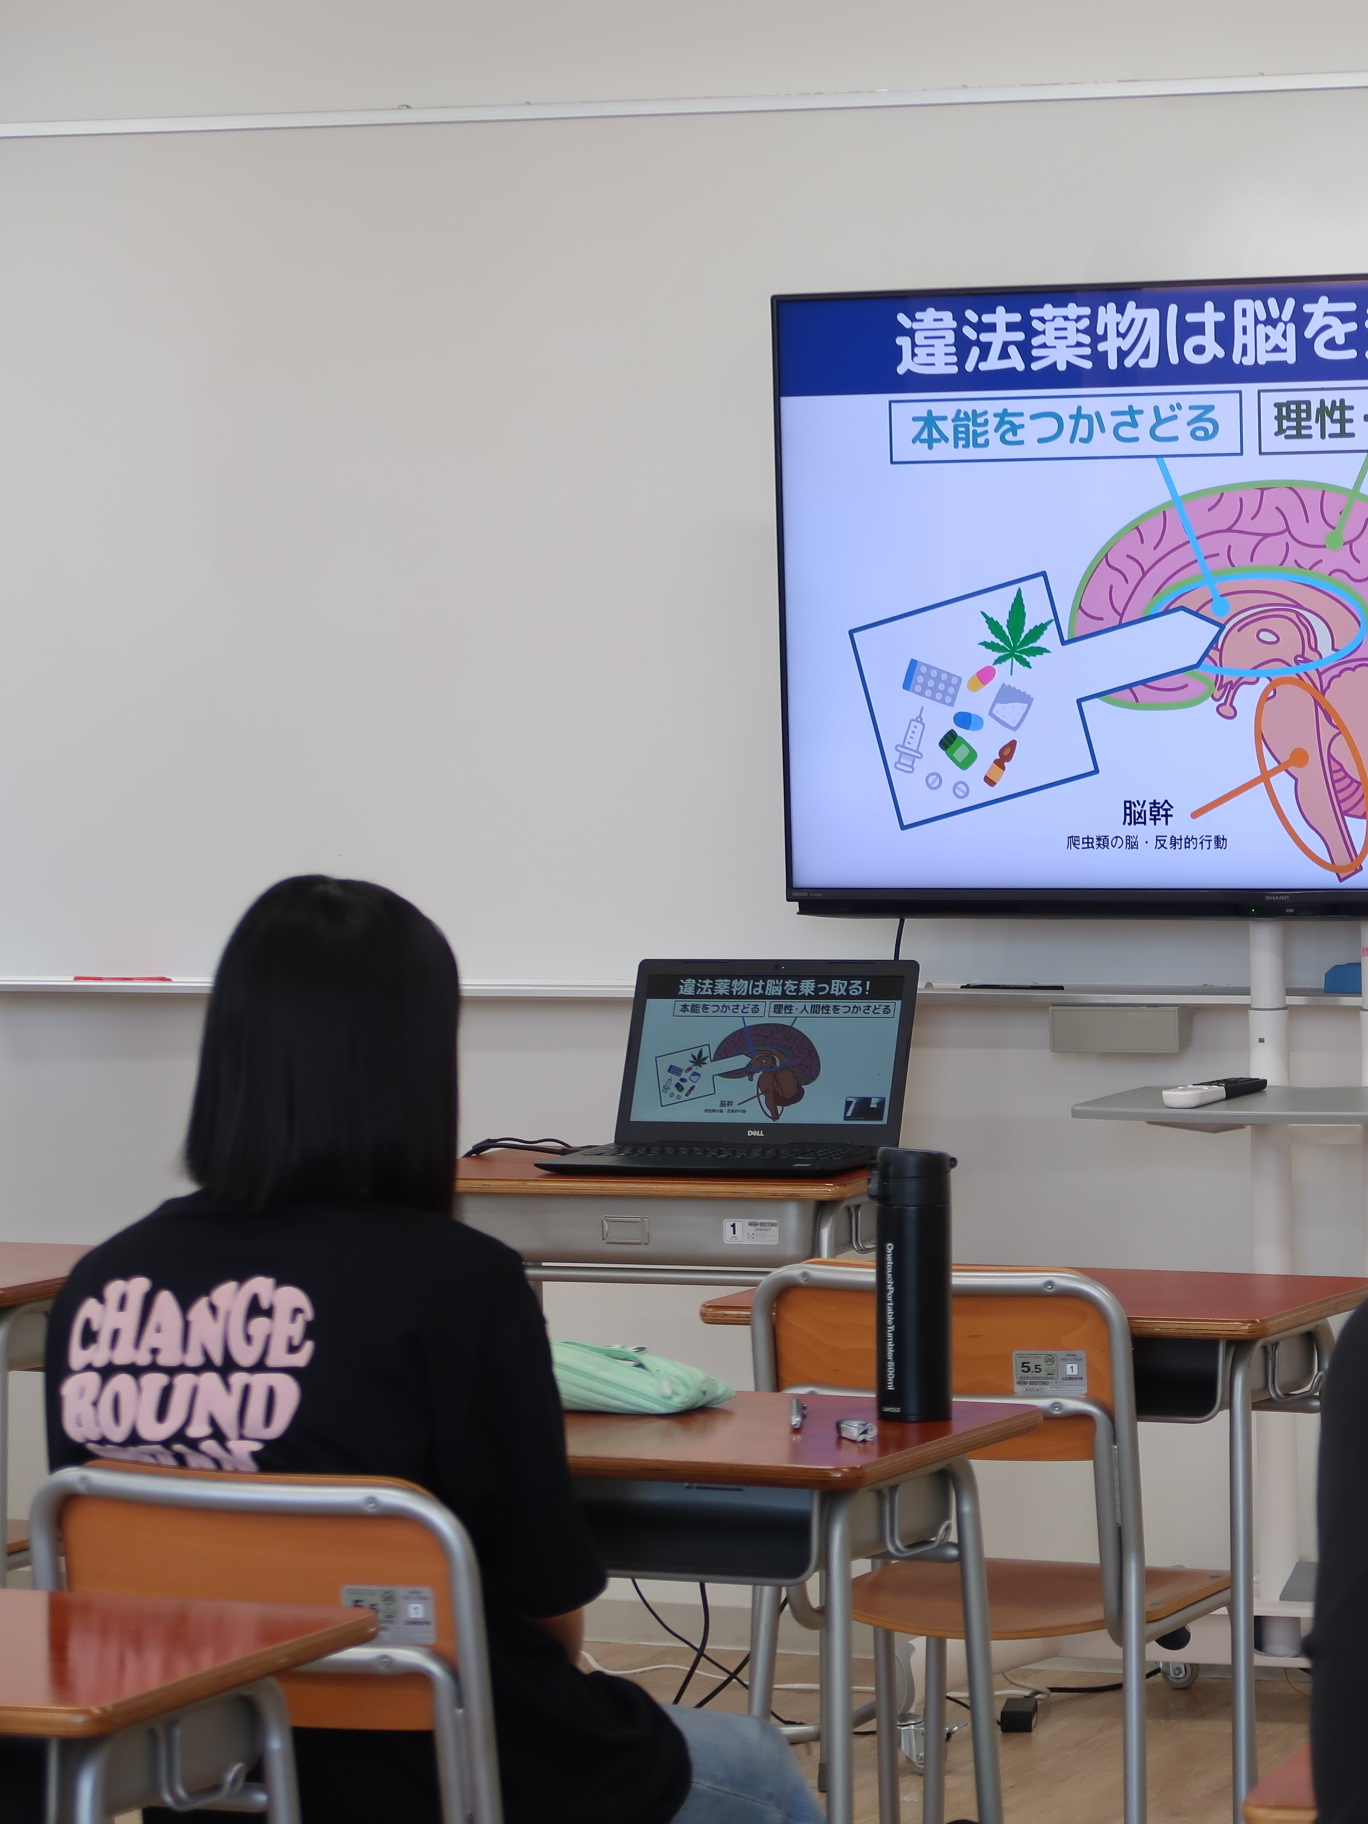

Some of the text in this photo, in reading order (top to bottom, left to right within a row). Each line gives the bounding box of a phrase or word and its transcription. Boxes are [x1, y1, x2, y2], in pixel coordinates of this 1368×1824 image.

[911, 402, 1221, 451] 本能をつかさどる
[1122, 799, 1174, 827] 脳幹
[1066, 835, 1228, 851] 爬虫類の脳・反射的行動
[678, 979, 871, 997] 違法薬物は脳を乗っ取る!
[679, 1003, 761, 1015] 本能をつかさどる
[729, 1222, 737, 1236] 1
[68, 1275, 316, 1372] CHANGE
[1020, 1361, 1043, 1374] 5.5
